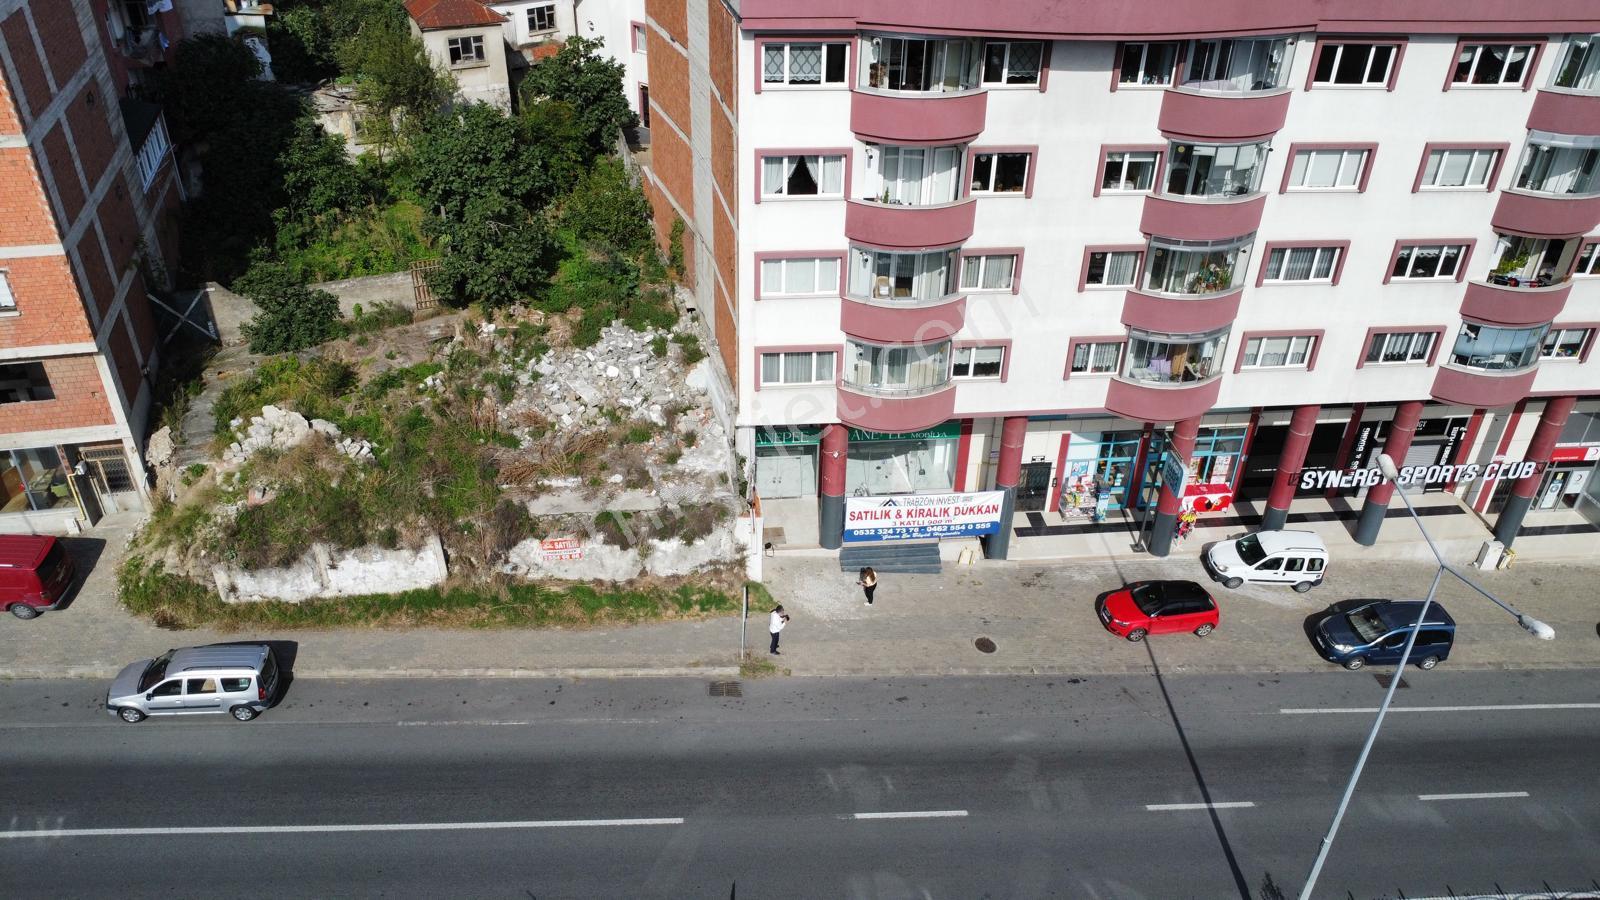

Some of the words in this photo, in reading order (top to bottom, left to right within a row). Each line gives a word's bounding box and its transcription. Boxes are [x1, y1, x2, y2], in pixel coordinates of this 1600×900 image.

[1398, 464, 1480, 484] SPORTS
[1483, 461, 1537, 481] CLUB
[903, 496, 935, 507] TRABZON
[936, 495, 960, 506] INVEST
[849, 509, 892, 521] SATILIK
[895, 509, 902, 519] &
[907, 506, 950, 519] KİRALIK
[954, 503, 999, 517] DÜKKAN
[899, 519, 925, 527] KATLI
